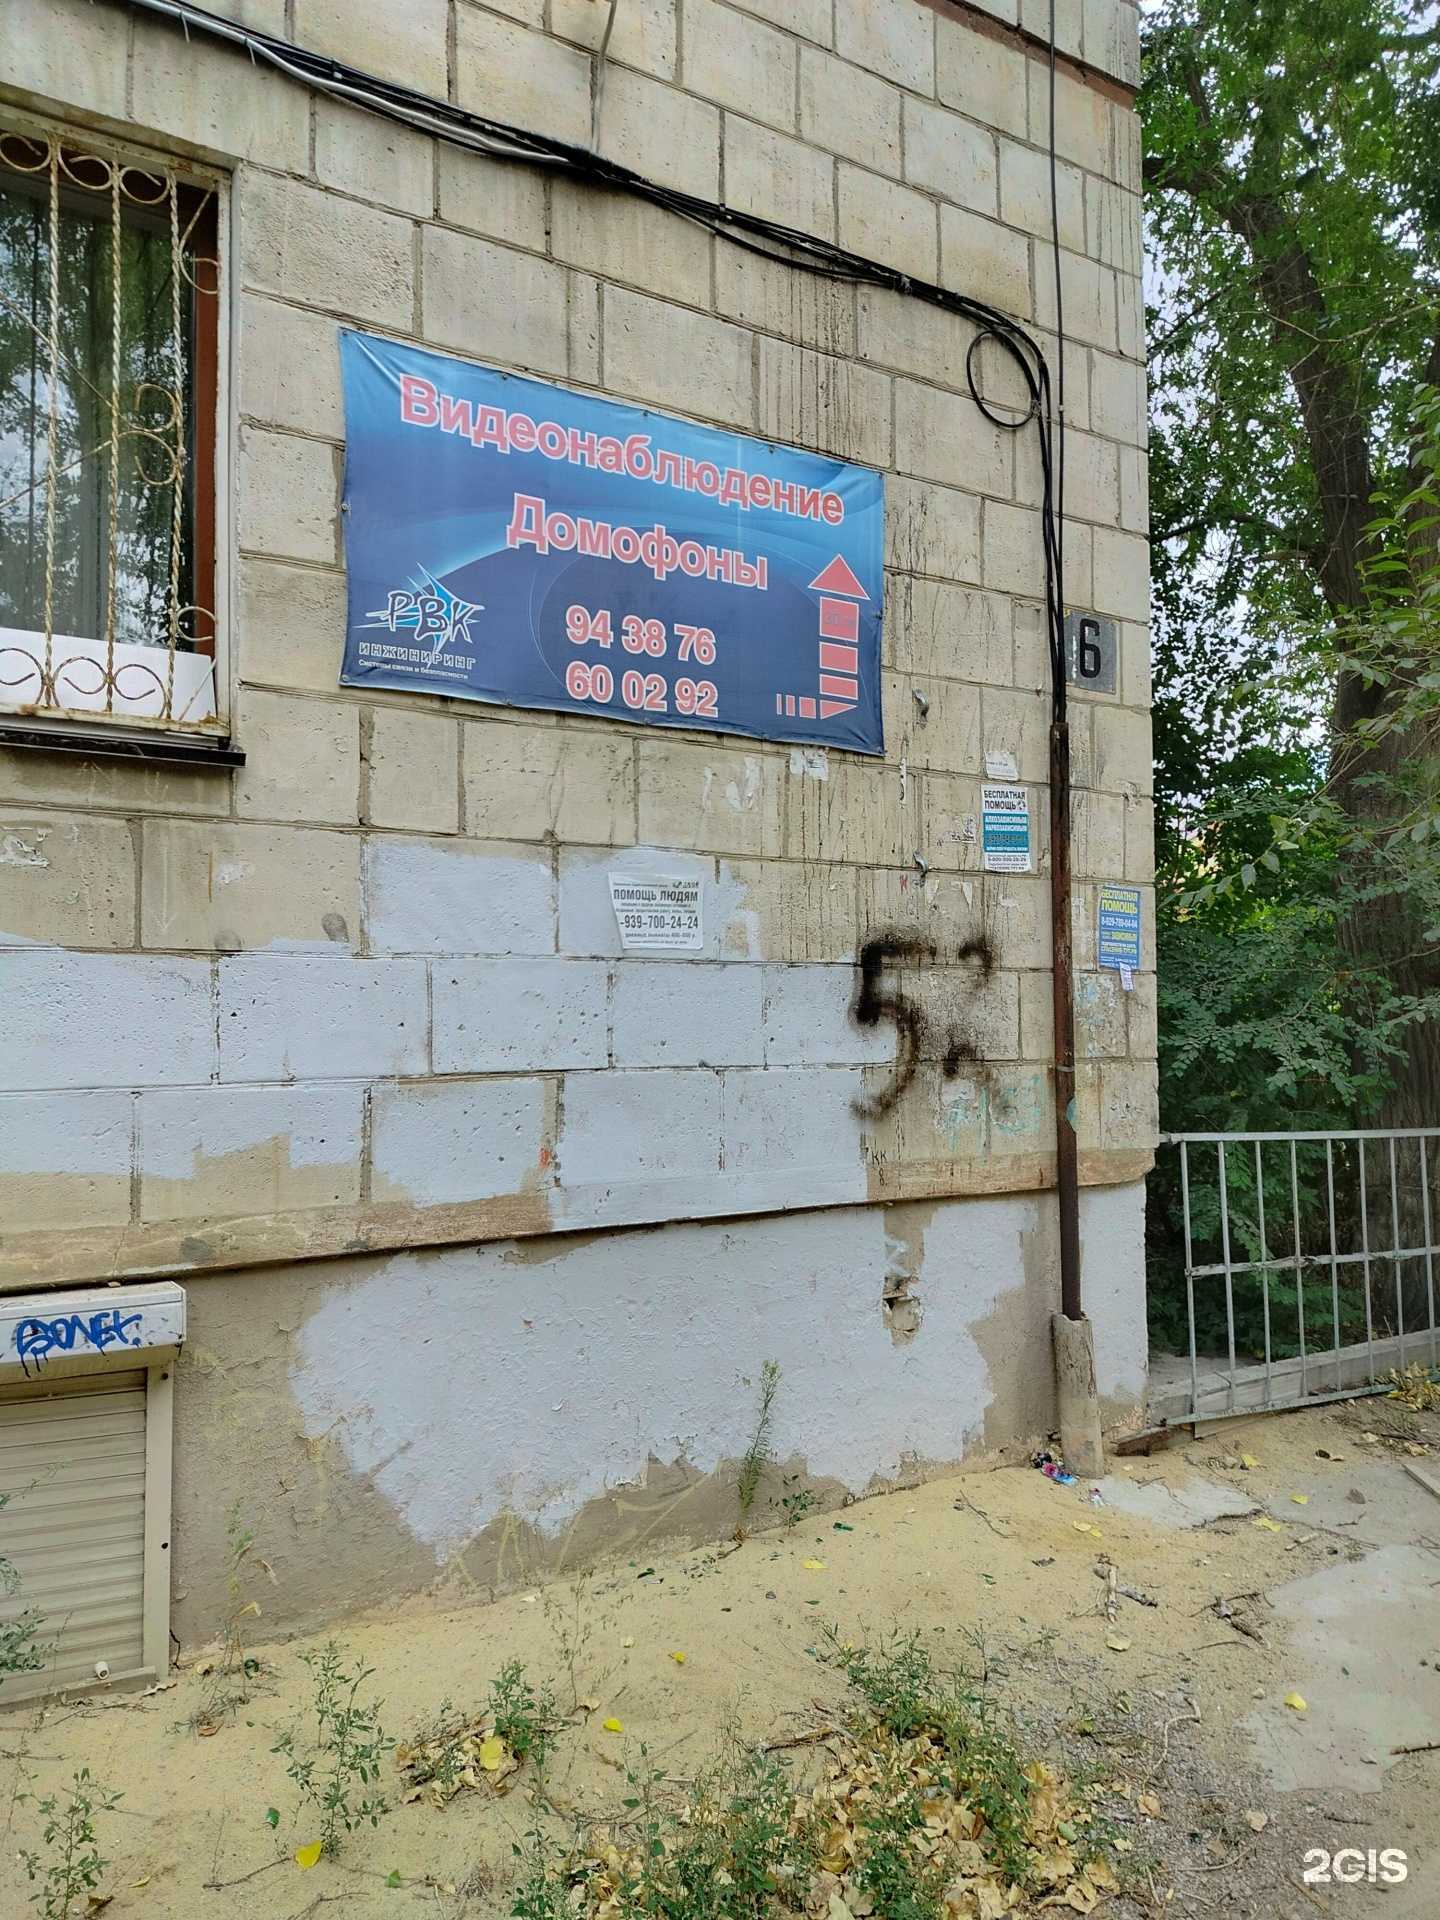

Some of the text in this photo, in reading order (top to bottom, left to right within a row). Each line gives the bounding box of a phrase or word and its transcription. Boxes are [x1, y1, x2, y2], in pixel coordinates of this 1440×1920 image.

[400, 373, 845, 525] Видеонаблюдение
[506, 492, 768, 590] Домофоны
[387, 590, 474, 643] РВК
[565, 605, 717, 665] 94 38 76
[358, 642, 476, 670] ИНЖИНИРИНГ
[1080, 618, 1101, 678] 6
[565, 661, 719, 718] 60 02 92
[983, 789, 1026, 800] БЕСПЛАТНАЯ
[984, 800, 1017, 811] ПОМОЩЬ
[613, 888, 698, 904] ПОМОЩЬ ЛЮДЯМ
